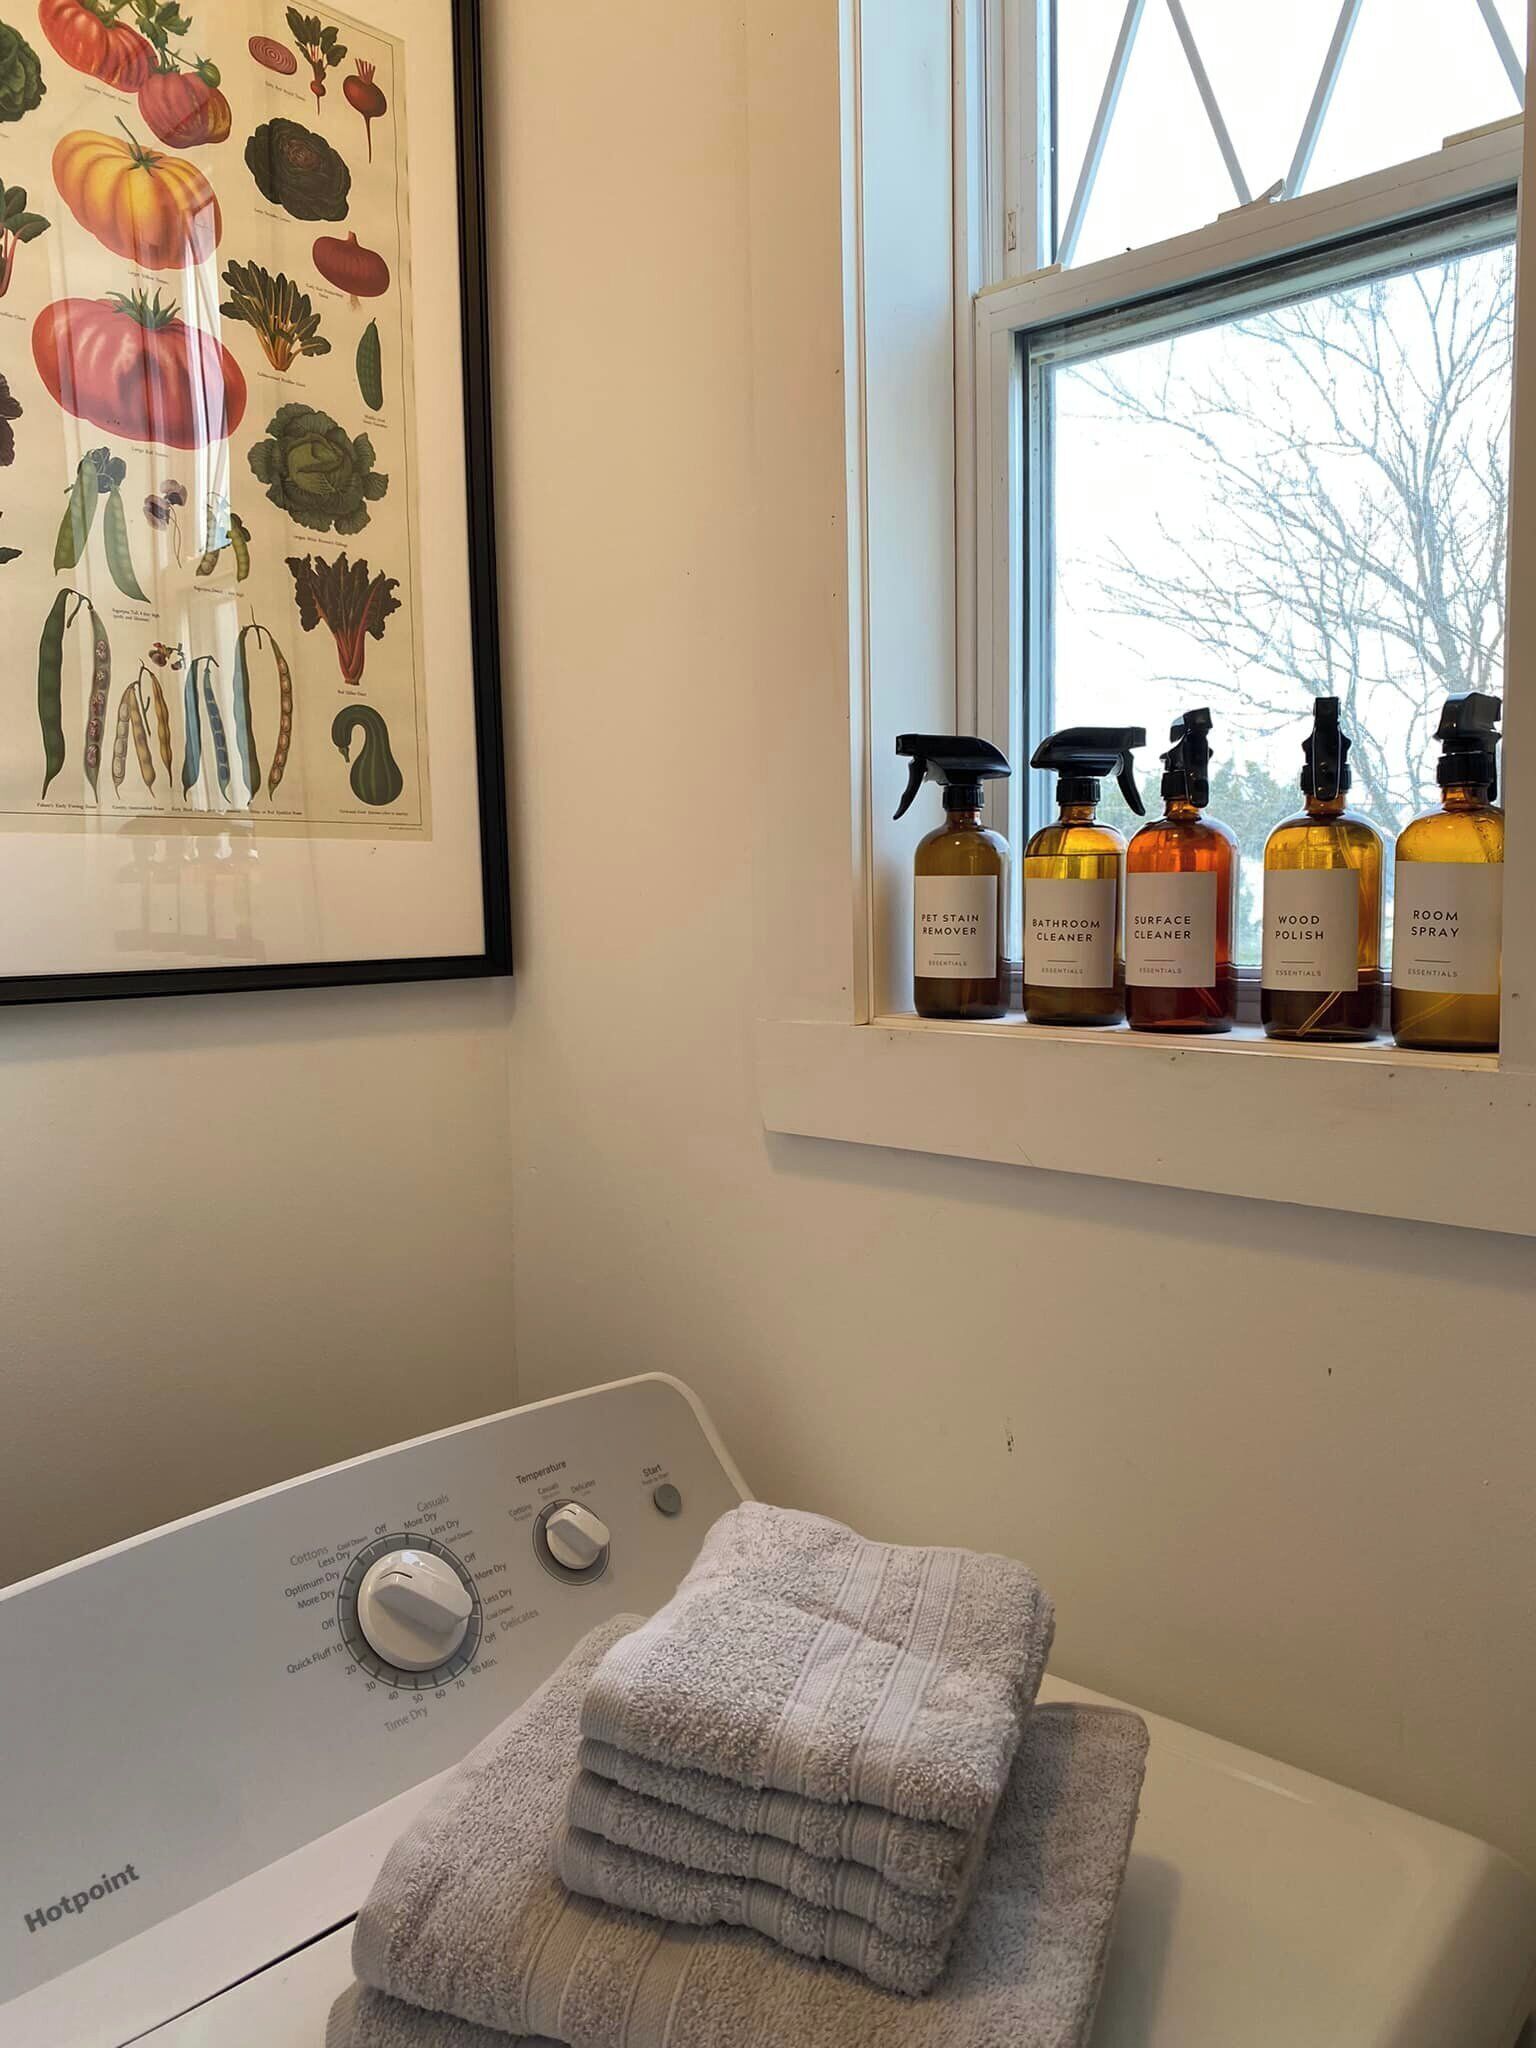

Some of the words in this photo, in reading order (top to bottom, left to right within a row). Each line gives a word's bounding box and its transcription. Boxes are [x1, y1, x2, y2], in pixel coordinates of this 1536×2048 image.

[920, 913, 938, 923] PET
[942, 913, 980, 923] STAIN
[1134, 915, 1192, 925] SURFACE
[1278, 915, 1320, 925] WOOD
[1413, 910, 1459, 921] ROOM
[1032, 918, 1101, 929] BATHROOM
[922, 926, 977, 936] REMOVER
[1134, 929, 1192, 940] CLEANER
[1275, 930, 1324, 940] POLISH
[1411, 926, 1459, 937] SPRAY
[1036, 932, 1093, 942] CLEANER
[1275, 969, 1322, 977] ESSENTIALS
[1407, 968, 1458, 978] ESSENTIALS
[515, 1460, 567, 1485] Temperature
[642, 1464, 662, 1478] Start
[416, 1493, 449, 1512] Casuals
[404, 1518, 423, 1529] More
[423, 1512, 437, 1522] Dry
[446, 1519, 459, 1529] Dry
[374, 1524, 387, 1535] Off
[290, 1546, 328, 1566] Cottons
[318, 1557, 335, 1568] Less
[336, 1550, 350, 1561] Dry
[464, 1552, 476, 1563] Off
[475, 1568, 493, 1581] More
[493, 1563, 506, 1573] Dry
[284, 1576, 325, 1597] Optimum
[325, 1572, 340, 1582] Dry
[297, 1595, 320, 1609] More
[320, 1590, 335, 1601] Dry
[483, 1593, 499, 1605] Less
[499, 1588, 512, 1598] Dry
[322, 1617, 335, 1630] Off
[500, 1609, 539, 1631] Delicates
[484, 1632, 497, 1644] Off
[287, 1657, 313, 1674] Quick
[312, 1646, 332, 1661] Fluff
[332, 1643, 343, 1653] 10
[345, 1664, 357, 1675] 20
[366, 1680, 376, 1692] 30
[454, 1679, 465, 1690] 70
[388, 1690, 399, 1701] 40
[412, 1693, 424, 1704] 50
[435, 1688, 446, 1699] 60
[384, 1716, 409, 1732] Time
[409, 1704, 428, 1720] Dry
[23, 1863, 140, 1934] Hotpoint
